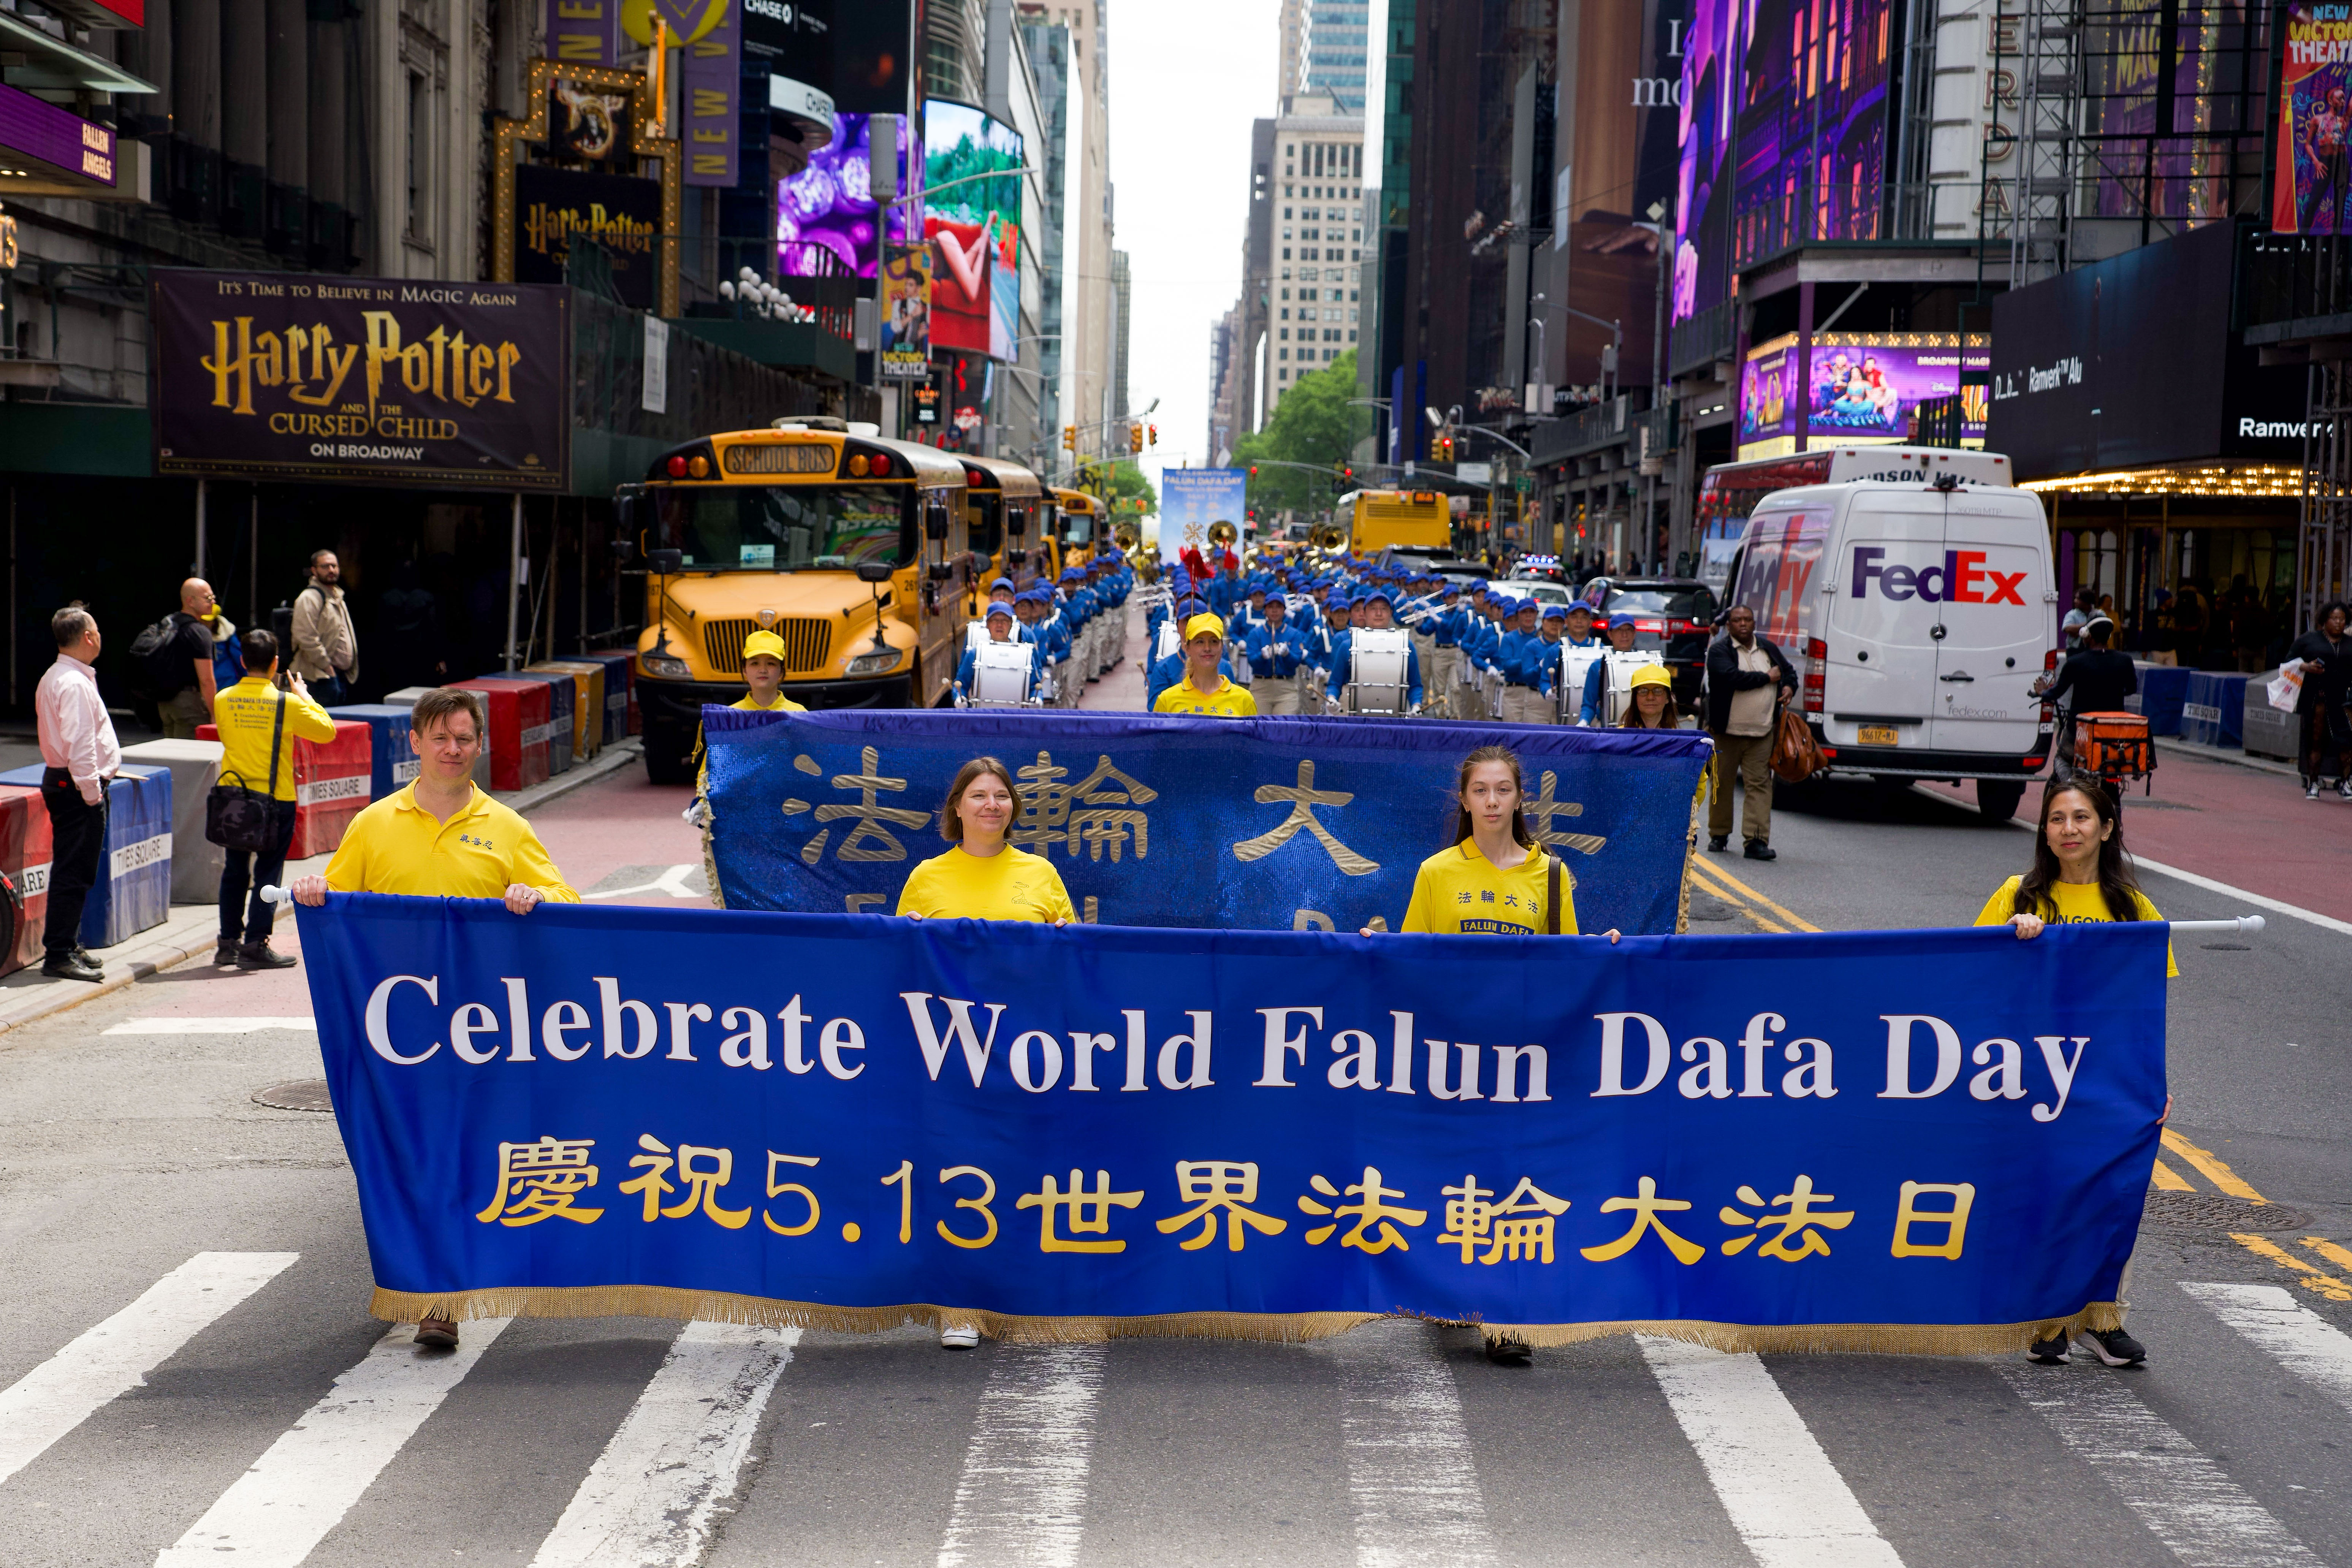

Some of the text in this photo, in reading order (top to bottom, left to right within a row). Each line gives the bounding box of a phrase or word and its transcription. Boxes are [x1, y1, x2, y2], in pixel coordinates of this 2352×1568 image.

[744, 0, 783, 21] CHASE
[2312, 3, 2350, 21] NEW
[2289, 39, 2352, 64] THEAT
[82, 123, 109, 155] FALLEN
[693, 88, 728, 175] NEW
[82, 150, 112, 180] ANGELS
[401, 286, 464, 304] MAGIC
[469, 291, 517, 306] AGAIN
[200, 311, 521, 428] Harry Potter
[882, 361, 928, 375] THEATER
[2068, 356, 2083, 385] Alu
[340, 403, 402, 414] AND THE
[269, 413, 459, 440] CURSED CHILD
[310, 443, 424, 461] ON BROADWAY
[733, 445, 827, 472] SCHOOL BUS
[1164, 475, 1196, 485] FALUN
[1197, 477, 1223, 486] DAFA
[1736, 513, 1814, 648] FedEx
[1852, 546, 2028, 606] FedEx
[1948, 704, 2007, 718] fedex.com
[329, 779, 360, 797] SQUARE
[135, 838, 161, 865] SQUARE
[1458, 890, 1538, 914] 法輪大法
[1464, 922, 1529, 935] FALUN DAFA
[365, 975, 2091, 1122] Celebrate World Falun Dafa Day
